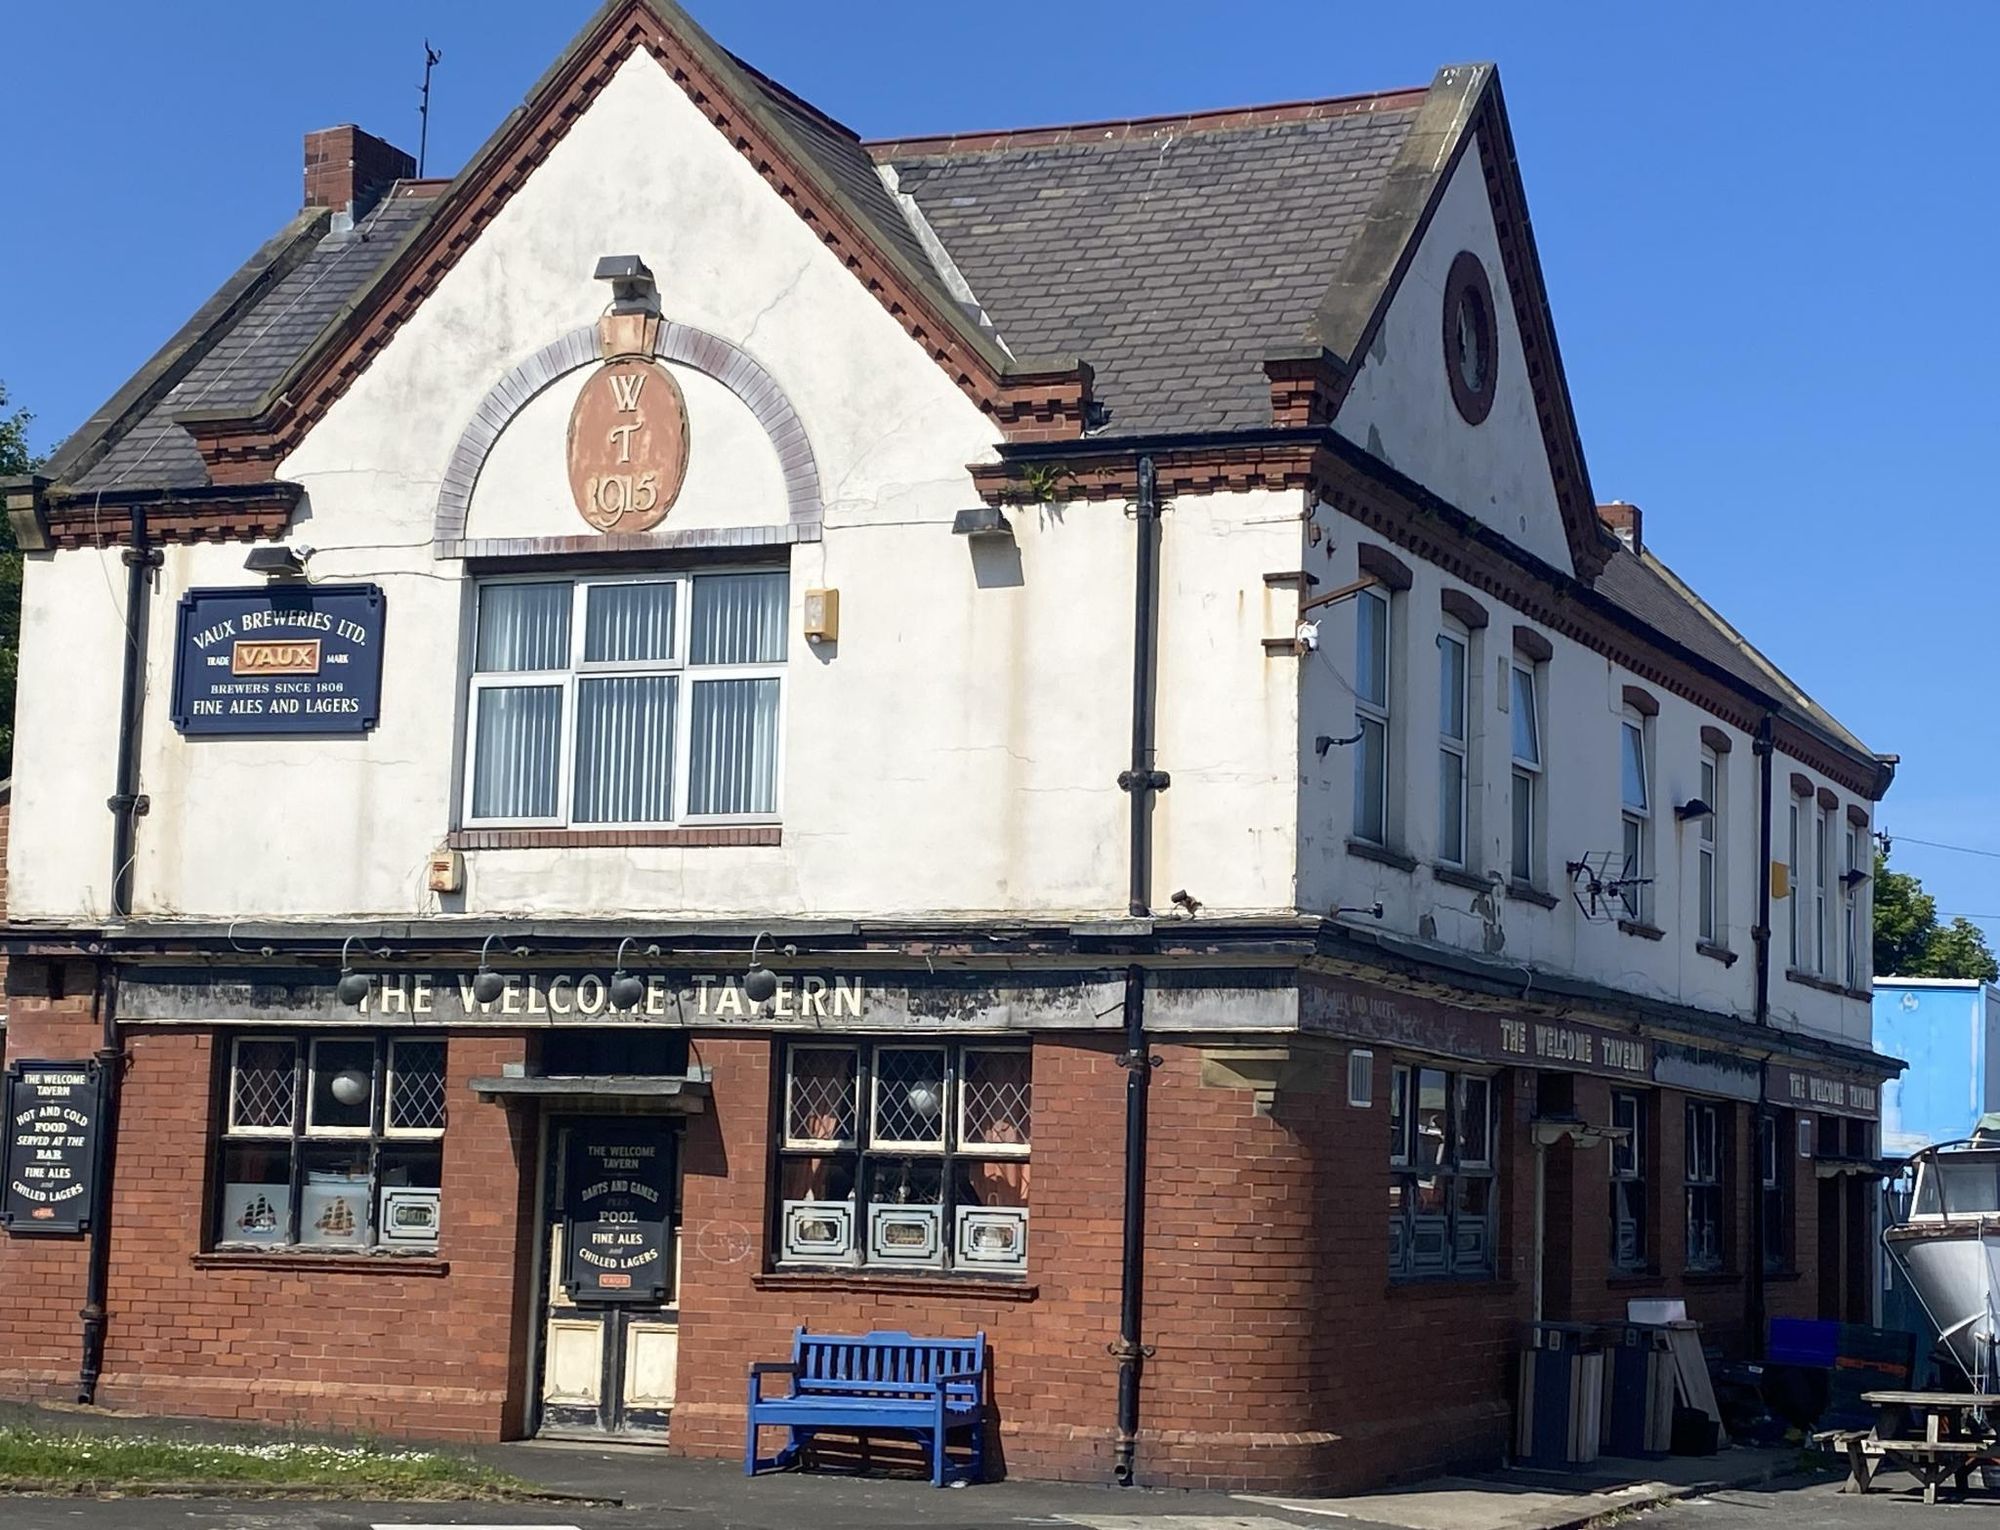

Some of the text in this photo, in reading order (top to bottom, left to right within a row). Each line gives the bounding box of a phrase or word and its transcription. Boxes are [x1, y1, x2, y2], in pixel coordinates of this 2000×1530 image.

[609, 375, 647, 412] W
[610, 420, 644, 463] T
[586, 473, 659, 527] 1915
[193, 610, 367, 649] VAUX BREWERIES LTD.
[207, 647, 349, 667] TRADE VAUX MARK
[211, 682, 344, 694] BREWERS SINCE 1806
[193, 698, 359, 715] FINE ALES AND LAGERS
[1500, 1018, 1645, 1072] THE WELCOME TAVERN
[24, 1074, 86, 1085] THE WELCOME
[37, 1086, 70, 1096] TAVERN
[16, 1106, 88, 1127] HOT AND COLD
[34, 1122, 68, 1133] FOOD
[16, 1136, 86, 1147] SERVED AT THE
[36, 1150, 62, 1160] BAR
[588, 1146, 656, 1157] THE WELCOME
[603, 1158, 639, 1169] TAVERN
[25, 1167, 72, 1179] FINE ALES
[12, 1181, 83, 1201] CHILLED LAGERS
[582, 1181, 608, 1201] DARTS
[611, 1180, 629, 1192] AND
[631, 1182, 659, 1203] GAMES
[598, 1211, 638, 1223] POOL
[592, 1233, 643, 1245] FINE ALES
[608, 1247, 623, 1255] and
[578, 1247, 659, 1269] CHILLED LAGERS
